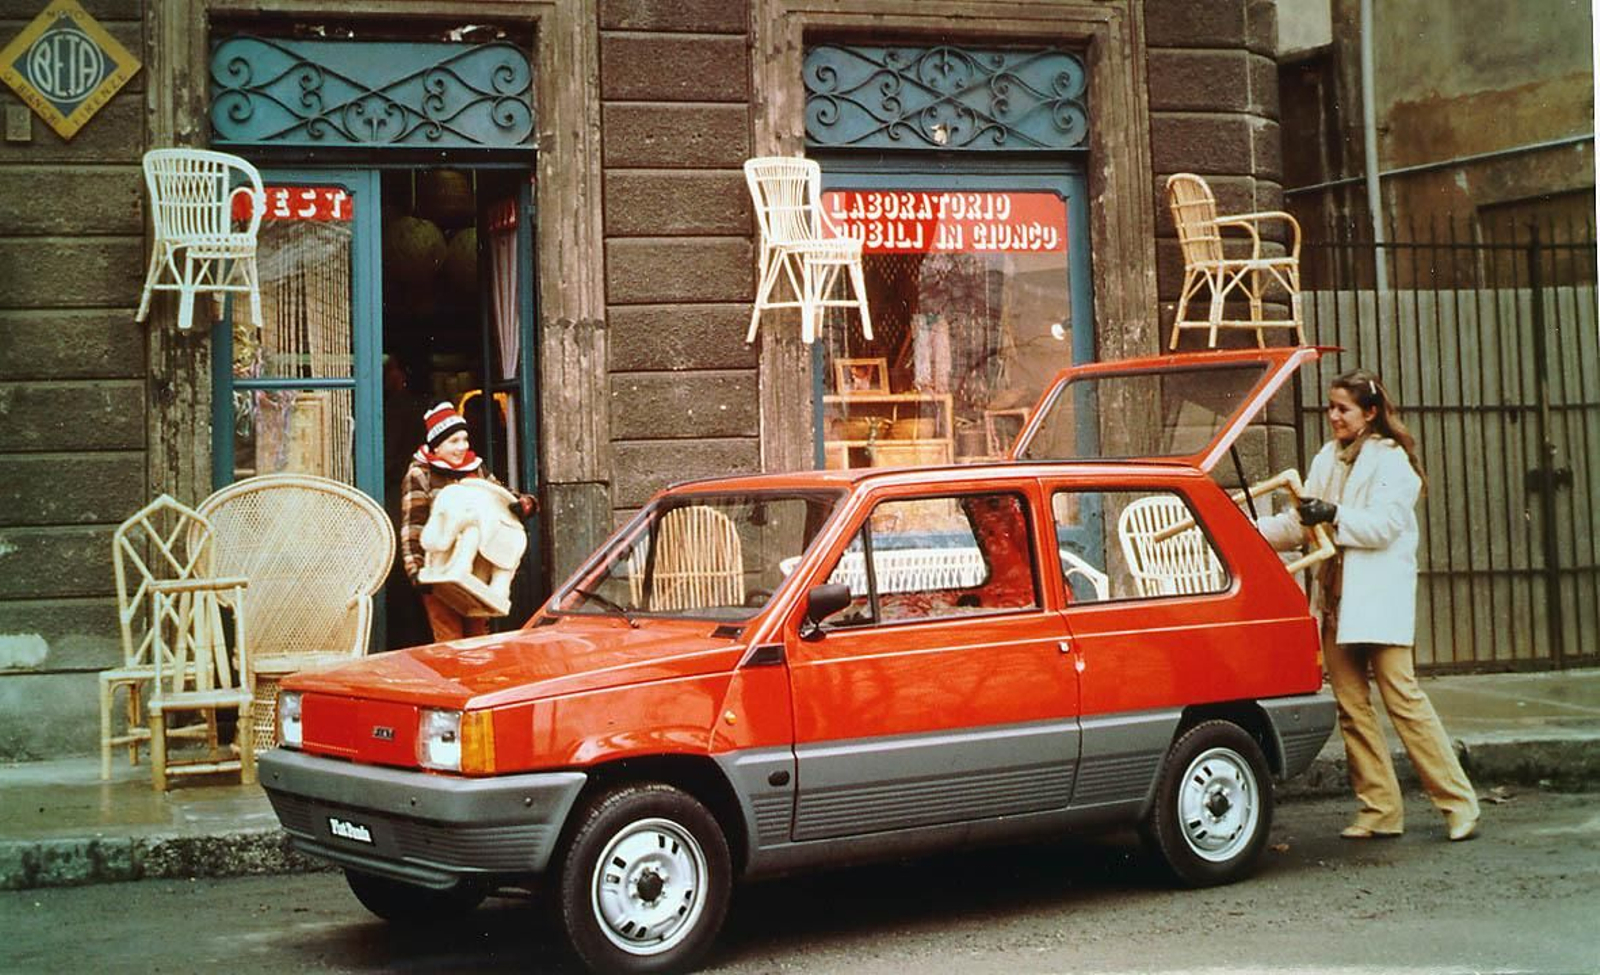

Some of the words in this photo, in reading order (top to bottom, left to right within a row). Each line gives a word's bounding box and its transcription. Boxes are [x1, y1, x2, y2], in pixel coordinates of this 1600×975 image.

[33, 35, 98, 97] BETA
[830, 192, 1011, 221] LABORATORIO
[935, 221, 964, 250] IN
[972, 221, 1057, 250] GIUNCO
